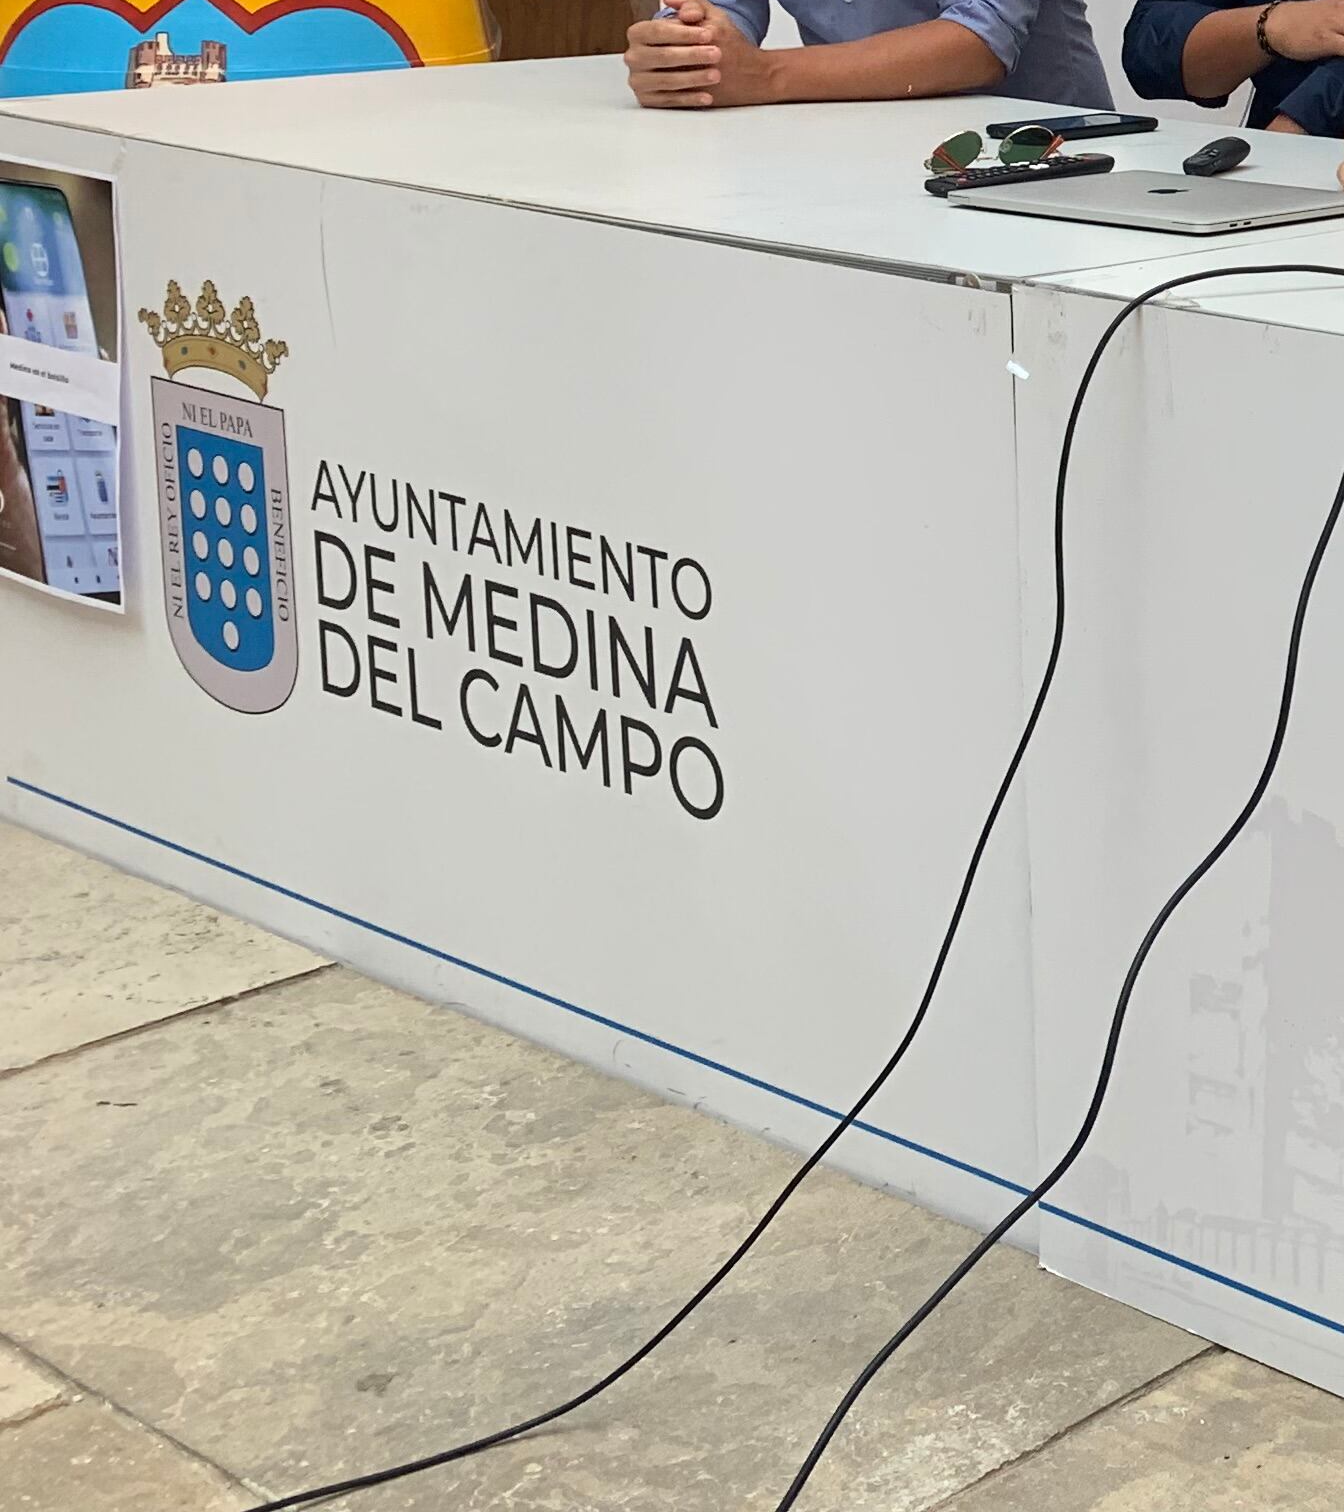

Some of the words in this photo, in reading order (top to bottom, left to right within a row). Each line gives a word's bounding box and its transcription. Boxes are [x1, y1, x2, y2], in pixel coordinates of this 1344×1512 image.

[181, 402, 197, 422] NI
[201, 407, 217, 428] EL
[220, 412, 253, 438] PAPA
[161, 422, 177, 502] OFICIO
[167, 513, 180, 554] REY
[270, 488, 290, 623] BENEFICIO
[311, 459, 712, 620] AYUNTAMIENTO
[171, 567, 182, 593] EL
[172, 597, 184, 619] NI
[314, 529, 400, 629] DE
[422, 561, 719, 729] MEDINA
[318, 618, 442, 730] DEL
[459, 668, 724, 820] CAMPO
